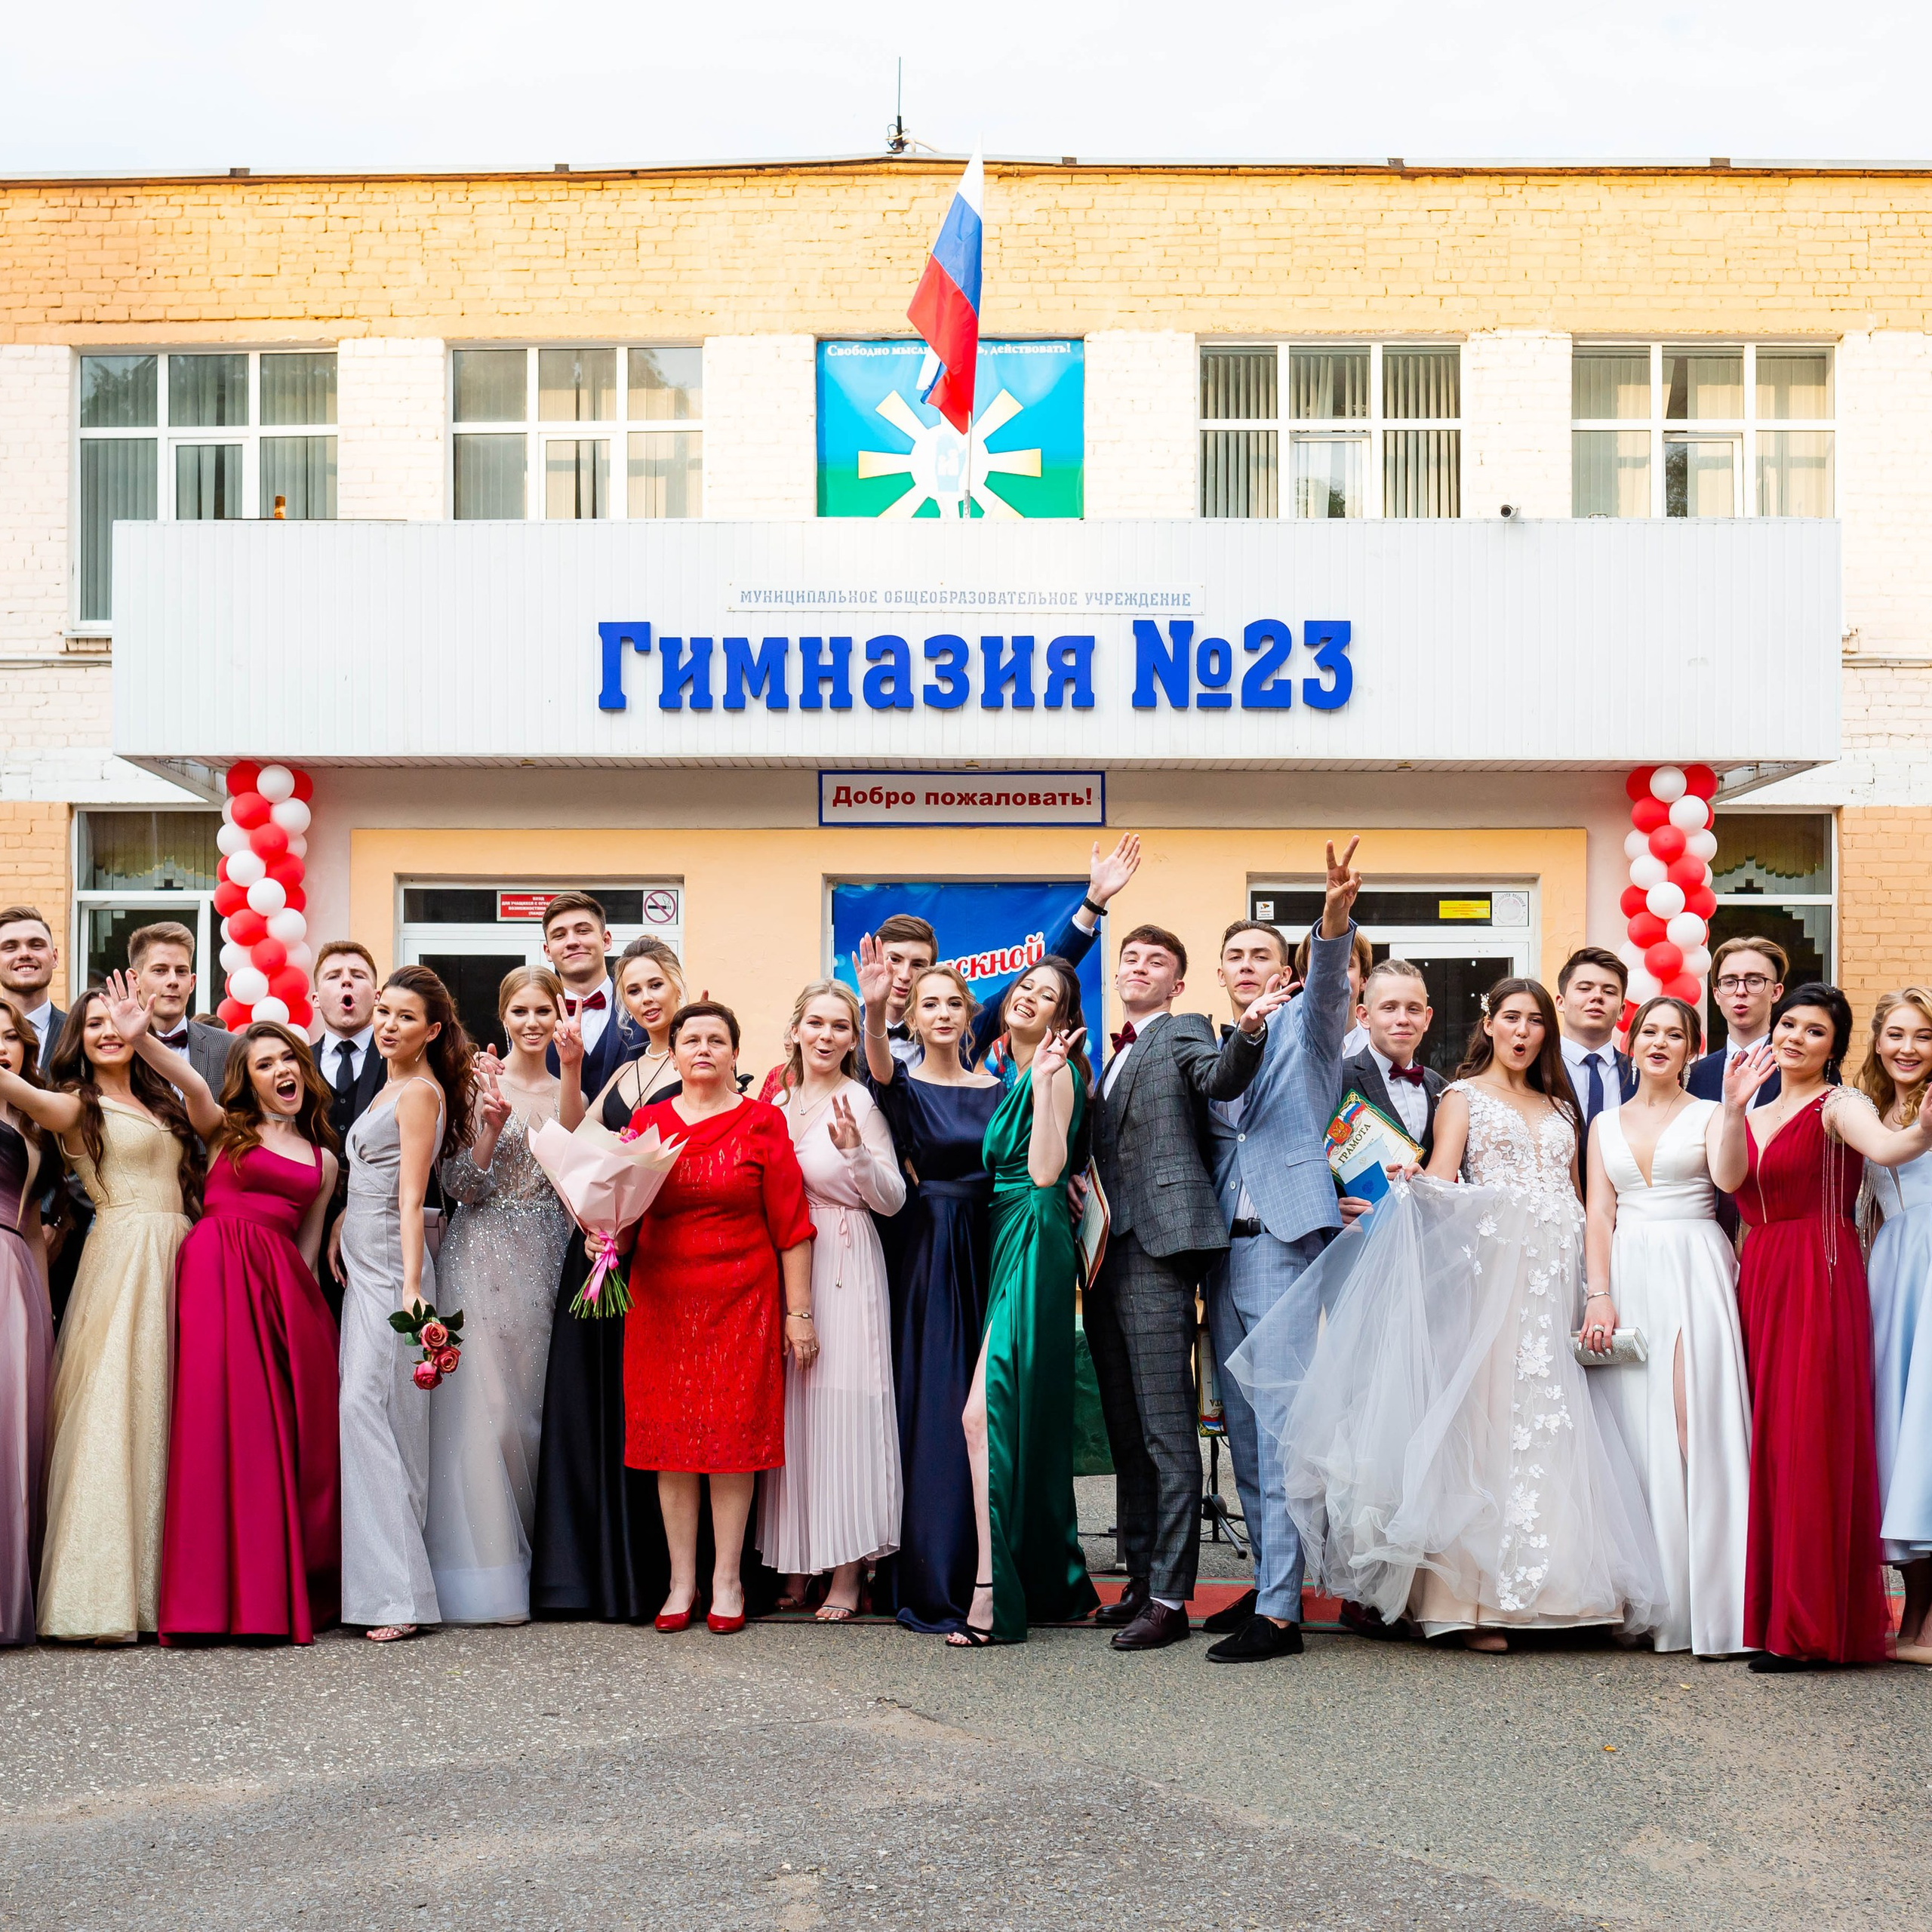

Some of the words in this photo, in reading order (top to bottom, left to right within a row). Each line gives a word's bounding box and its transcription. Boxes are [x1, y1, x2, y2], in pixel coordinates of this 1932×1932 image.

[826, 345, 890, 356] Свободно
[990, 343, 1071, 355] действовать!
[740, 590, 878, 605] МУНИЦИПАЛЬНОЕ
[884, 591, 1078, 606] ОБЩЕОБРАЗОВАТЕЛЬНОЕ
[1084, 592, 1192, 608] УЧРЕЖДЕНИЕ
[598, 621, 1095, 709] Гимназия
[1131, 620, 1353, 710] №23
[832, 786, 915, 809] Добро
[924, 786, 1092, 806] пожаловать!
[937, 933, 1044, 980] скной
[1337, 1123, 1371, 1164] ГРАМОТА
